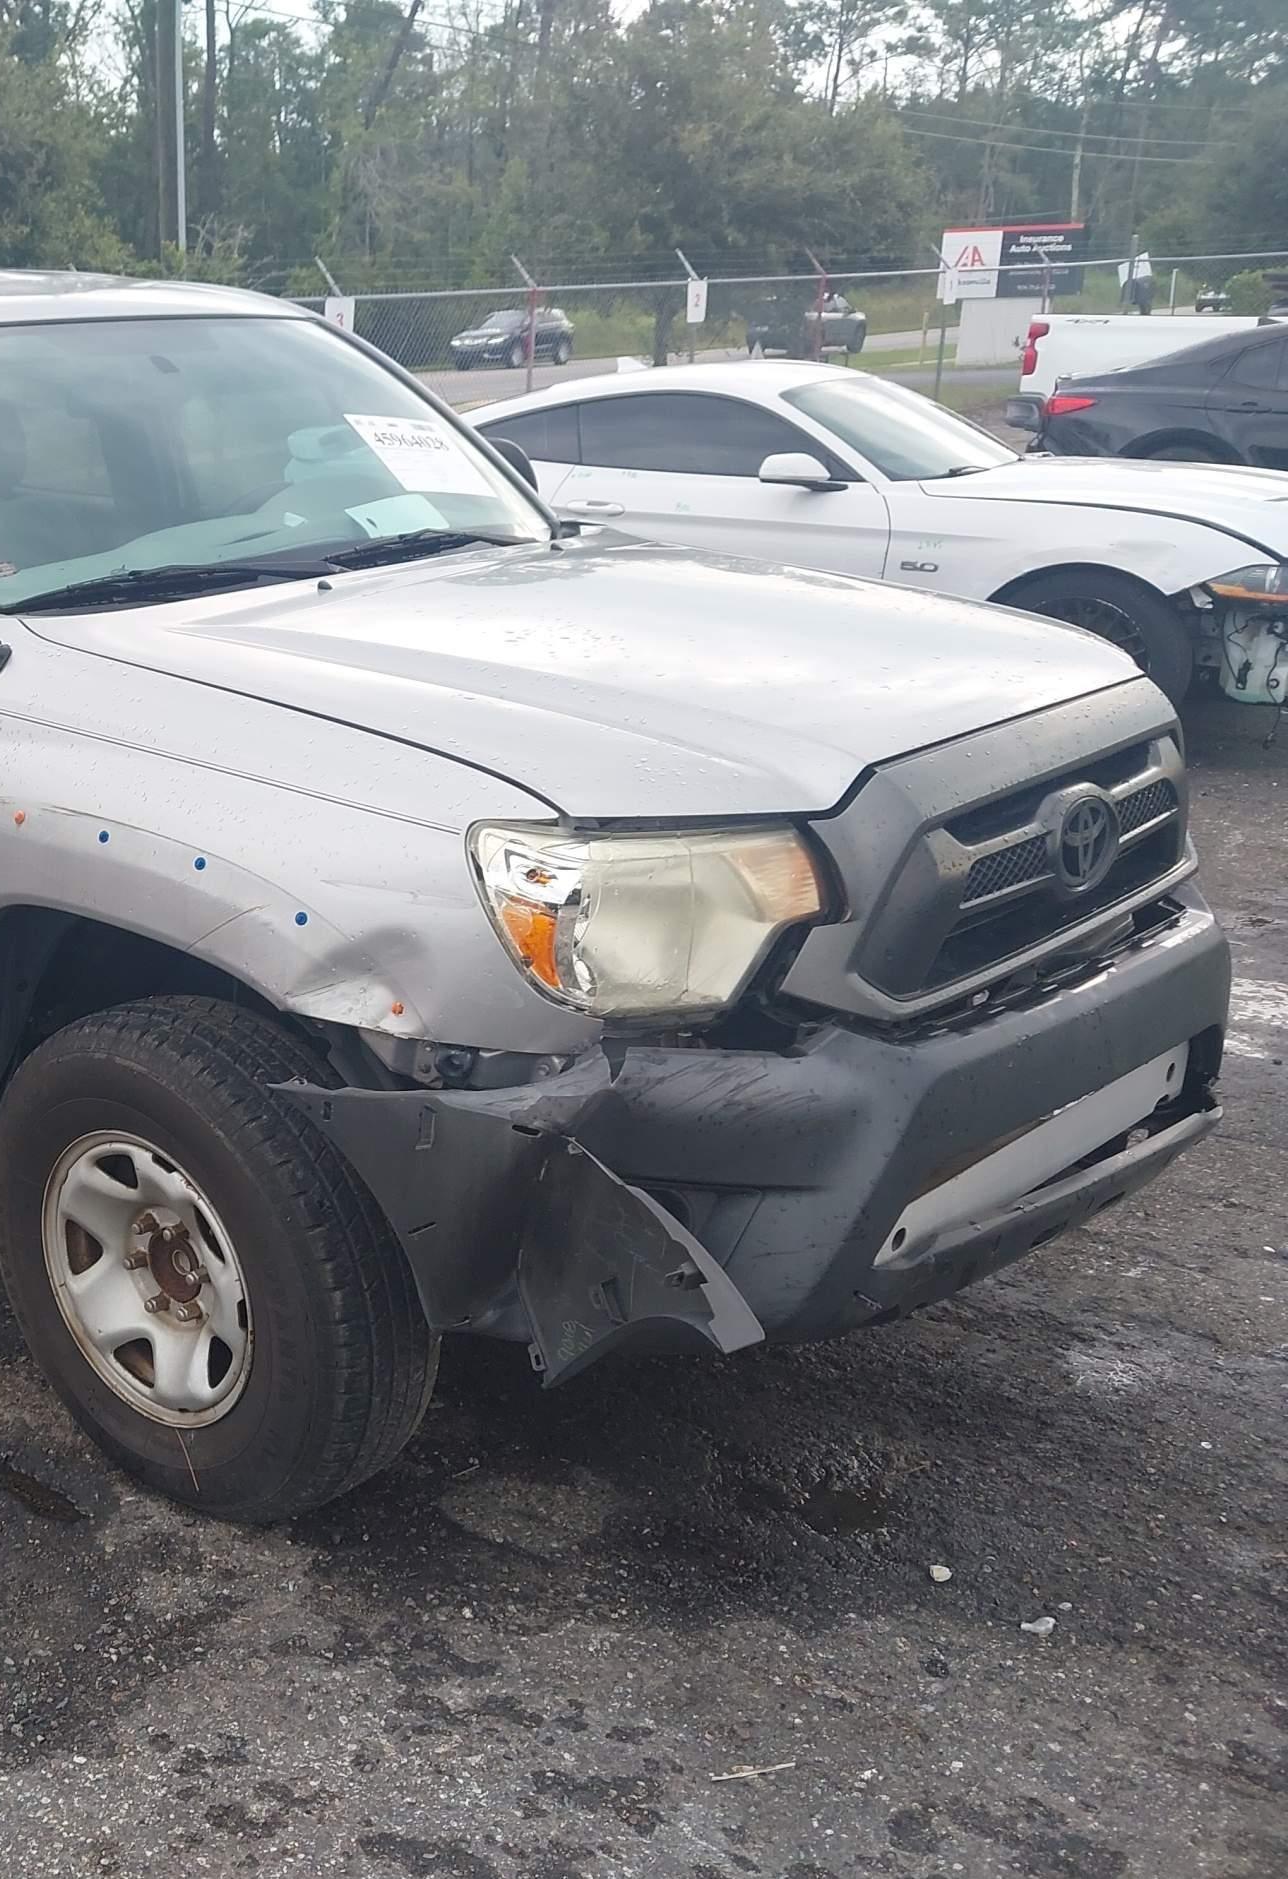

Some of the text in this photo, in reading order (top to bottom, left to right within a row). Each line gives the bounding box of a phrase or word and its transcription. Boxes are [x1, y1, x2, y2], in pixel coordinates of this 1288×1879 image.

[1020, 234, 1065, 244] Insurance
[1009, 240, 1073, 253] Auto Auctions
